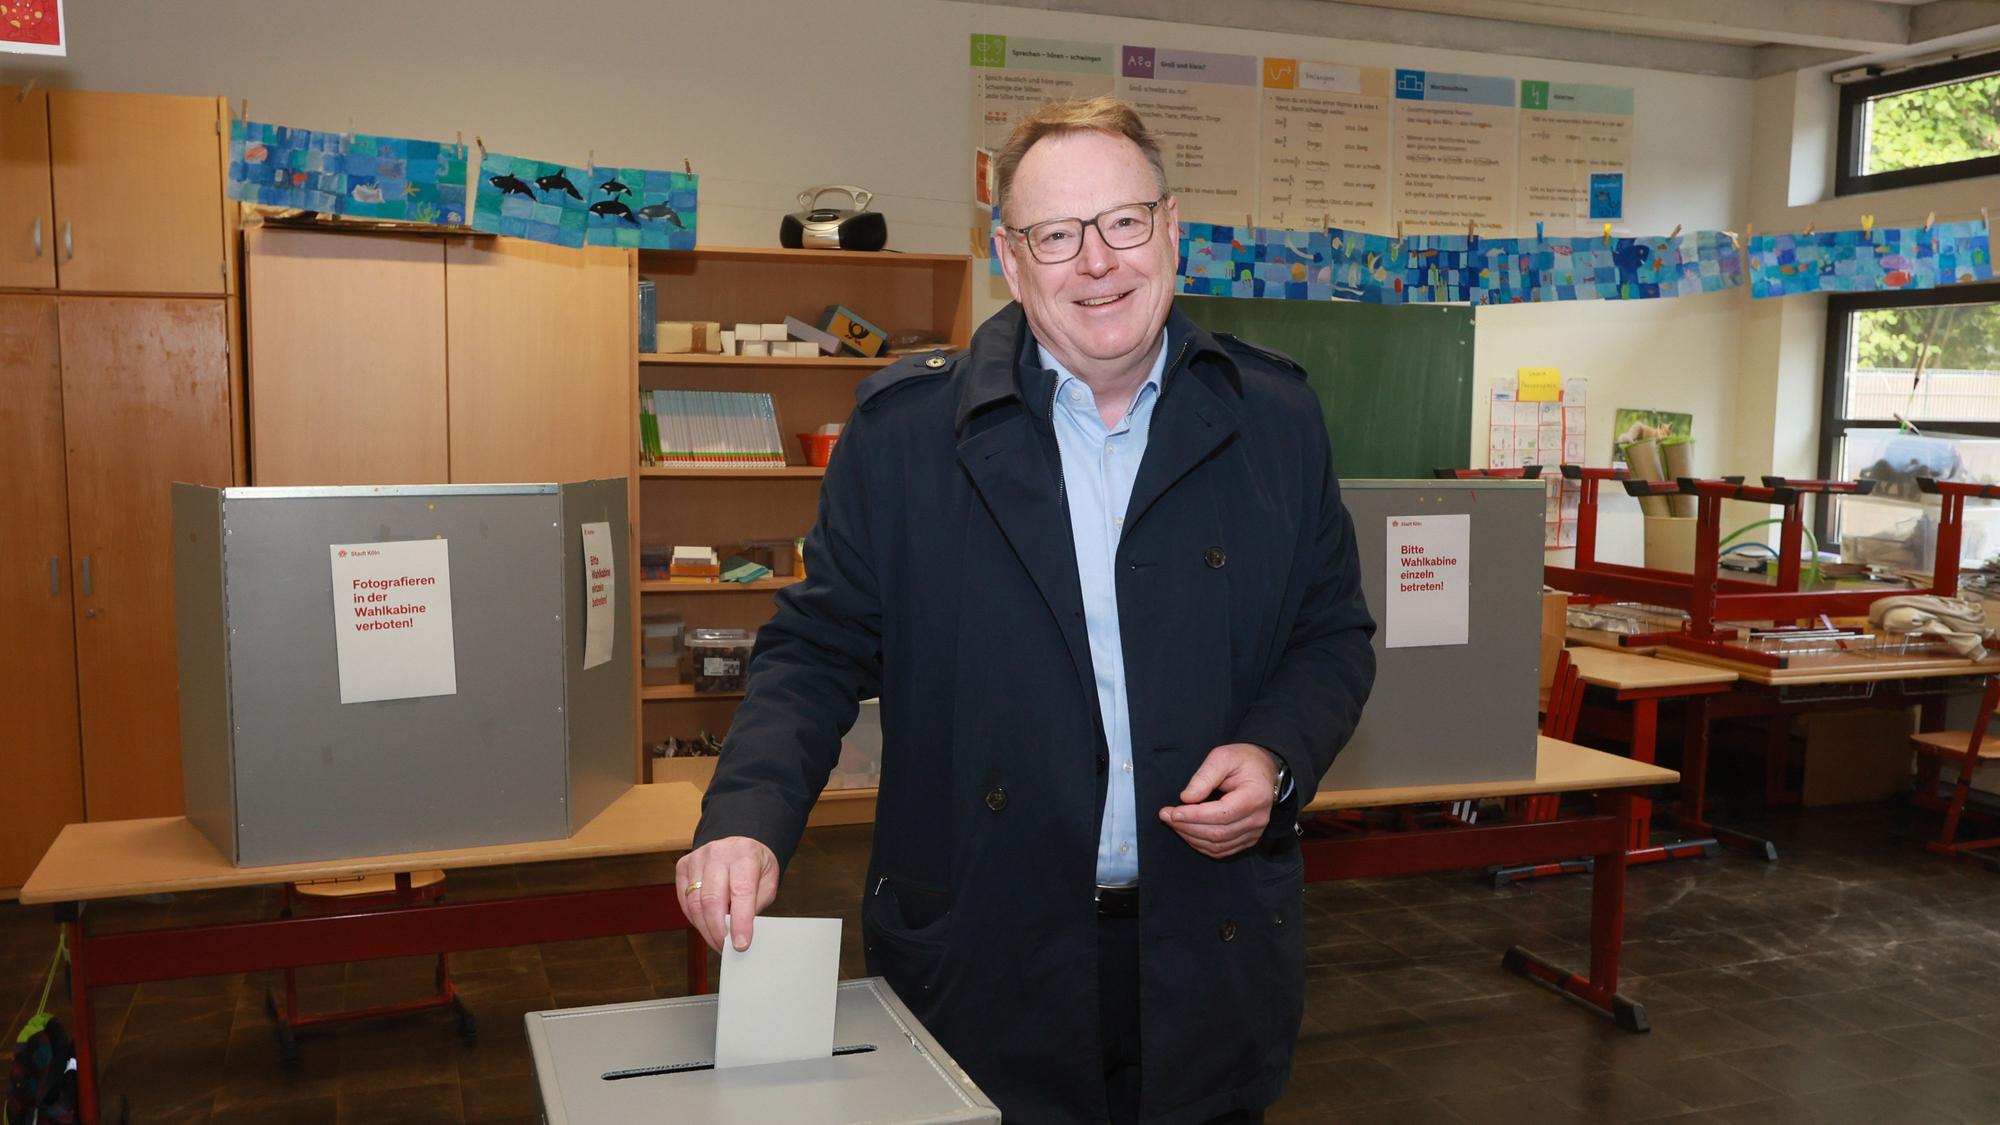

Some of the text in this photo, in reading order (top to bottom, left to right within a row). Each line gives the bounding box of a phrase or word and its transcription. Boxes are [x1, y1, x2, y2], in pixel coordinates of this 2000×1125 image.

[350, 550, 367, 558] Stadt
[1400, 545, 1425, 555] Bitte
[1400, 556, 1457, 568] Wahlkabine
[1400, 570, 1435, 580] einzeln
[352, 576, 436, 590] Fotografieren
[1400, 581, 1444, 593] betreten!
[353, 592, 388, 604] in der
[354, 603, 427, 618] Wahlkabine
[355, 618, 414, 632] verboten!
